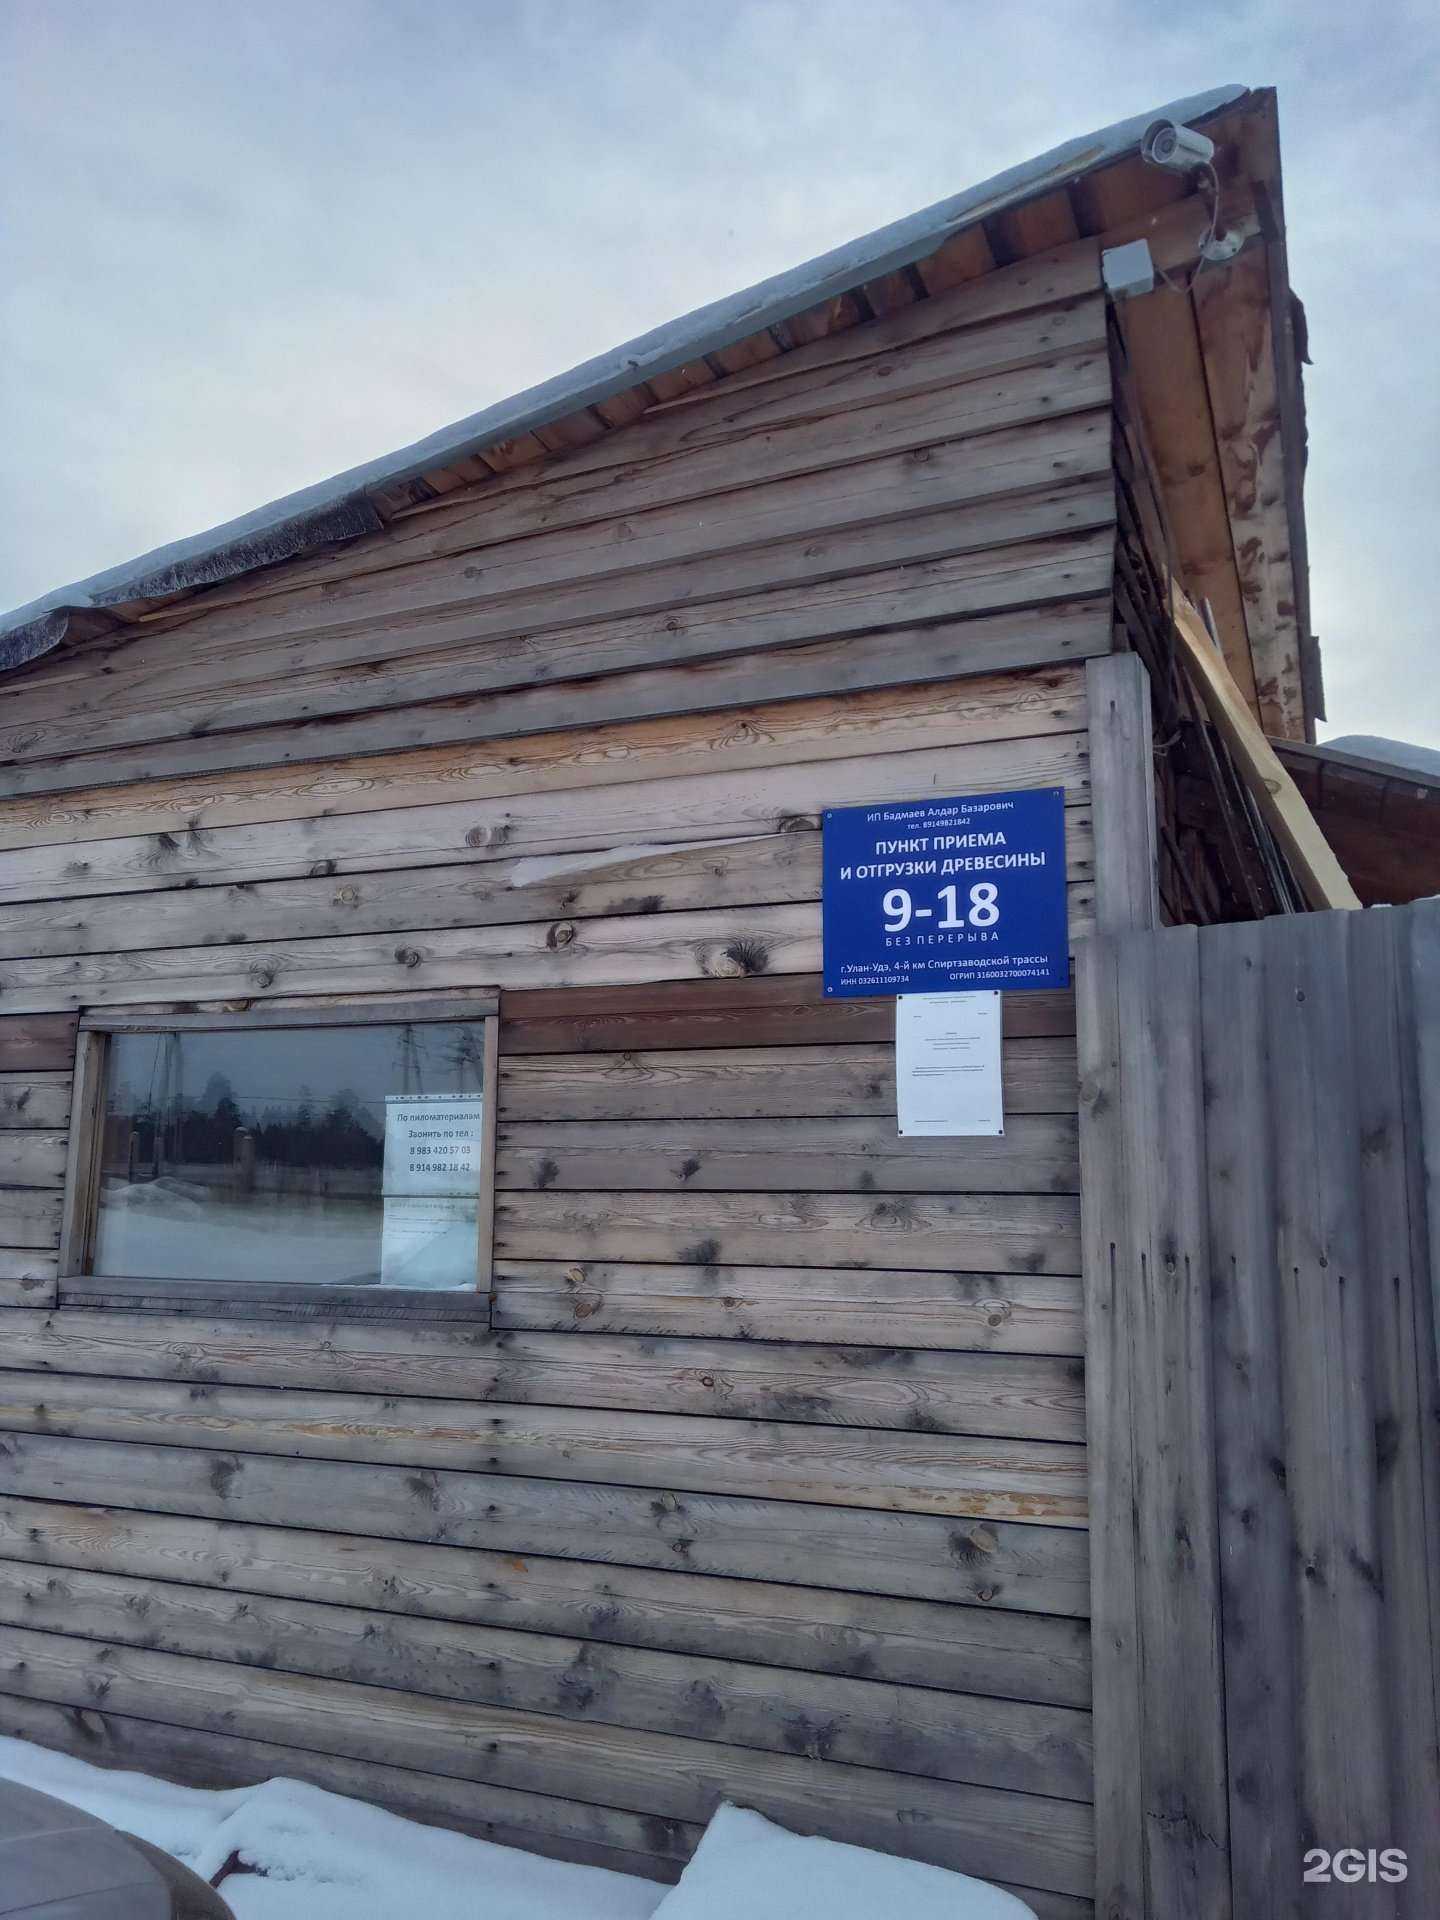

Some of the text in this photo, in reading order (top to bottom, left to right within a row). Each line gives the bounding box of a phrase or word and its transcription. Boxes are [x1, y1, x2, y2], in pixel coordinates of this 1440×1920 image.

[867, 801, 1014, 822] ИП Бадмаев Алдар Базарович
[875, 831, 1006, 855] ПУНКТ ПРИЕМА
[840, 851, 1046, 880] И ОТГРУЗКИ ДРЕВЕСИНЫ
[882, 882, 1000, 932] 9-18
[885, 931, 1000, 947] БЕЗ ПЕРЕРЫВА
[894, 960, 909, 970] 4-й
[912, 962, 925, 970] км
[927, 955, 1010, 970] Спиртзаводской
[1012, 955, 1048, 966] трассы
[950, 970, 975, 981] ОГРИП
[397, 1113, 408, 1121] По
[408, 1130, 441, 1138] Звонить
[443, 1130, 454, 1138] по
[409, 1163, 415, 1172] 8
[416, 1163, 431, 1172] 914
[432, 1163, 447, 1172] 982
